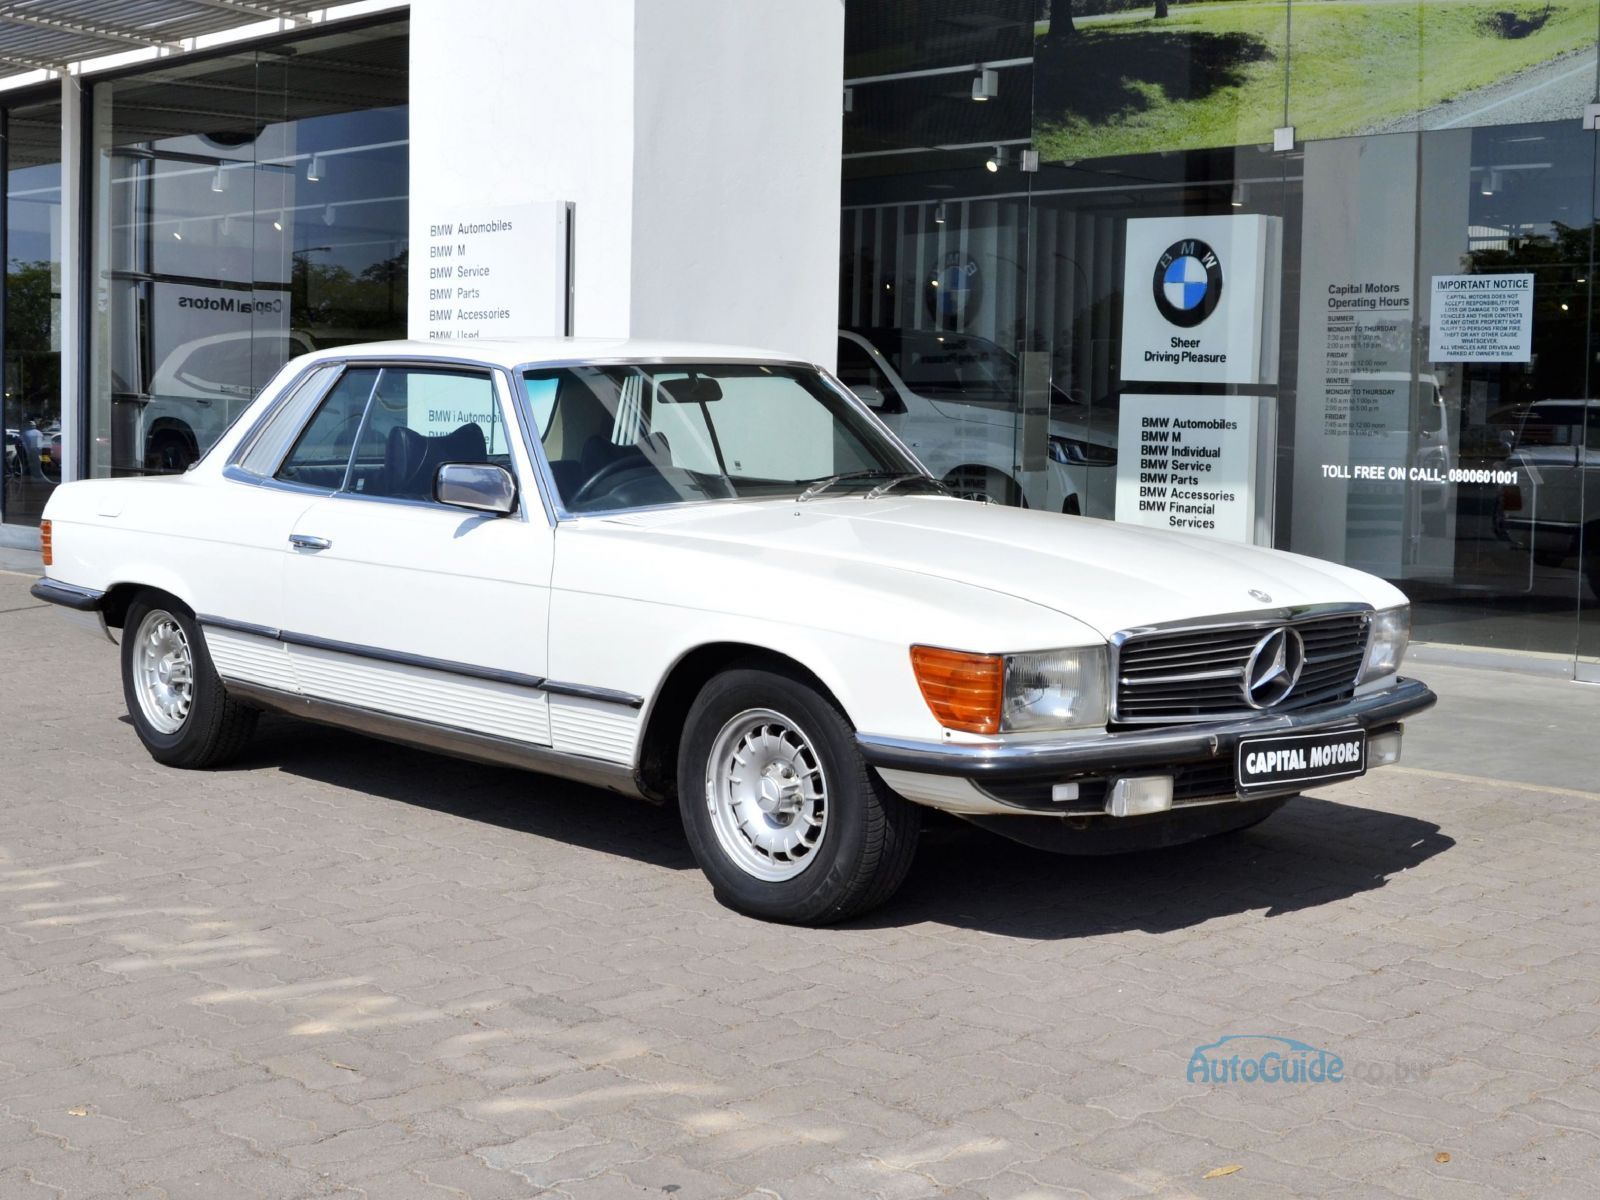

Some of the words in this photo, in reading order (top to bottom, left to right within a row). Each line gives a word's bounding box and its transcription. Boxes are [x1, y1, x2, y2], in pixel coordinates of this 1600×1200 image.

[430, 224, 453, 237] BMW
[458, 220, 512, 235] Automobiles
[430, 245, 452, 258] BMW
[458, 244, 465, 256] M
[1161, 242, 1217, 269] BMW
[430, 266, 452, 279] BMW
[458, 266, 490, 278] Service
[1328, 284, 1362, 296] Capital
[1365, 283, 1400, 294] Motors
[1438, 280, 1491, 289] IMPORTANT
[1494, 279, 1528, 289] NOTICE
[430, 288, 452, 300] BMW
[458, 288, 480, 299] Parts
[1328, 297, 1376, 309] Operating
[1379, 297, 1409, 306] Hours
[430, 309, 452, 321] BMW
[457, 308, 510, 320] Accessories
[1171, 337, 1200, 348] Sheer
[1144, 351, 1180, 364] Driving
[1182, 351, 1226, 363] Pleasure
[429, 410, 451, 422] BMW
[1142, 417, 1170, 428] BMW
[1173, 418, 1237, 430] Automobiles
[1142, 431, 1169, 442] BMW
[1172, 432, 1181, 442] M
[1141, 445, 1169, 456] BMW
[1172, 446, 1220, 458] Individual
[1141, 459, 1168, 470] BMW
[1172, 460, 1212, 472] Service
[1140, 473, 1168, 483] BMW
[1171, 474, 1198, 485] Parts
[1322, 465, 1351, 478] TOLL
[1354, 466, 1385, 479] FREE
[1388, 467, 1406, 480] ON
[1449, 469, 1518, 484] 0800601001
[1140, 486, 1167, 497] BMW
[1171, 488, 1235, 501] Accessories
[1139, 501, 1166, 512] BMW
[1170, 502, 1215, 514] Financial
[1169, 516, 1215, 529] Services
[1246, 749, 1307, 774] CAPITAL
[1310, 741, 1360, 768] MOTORS
